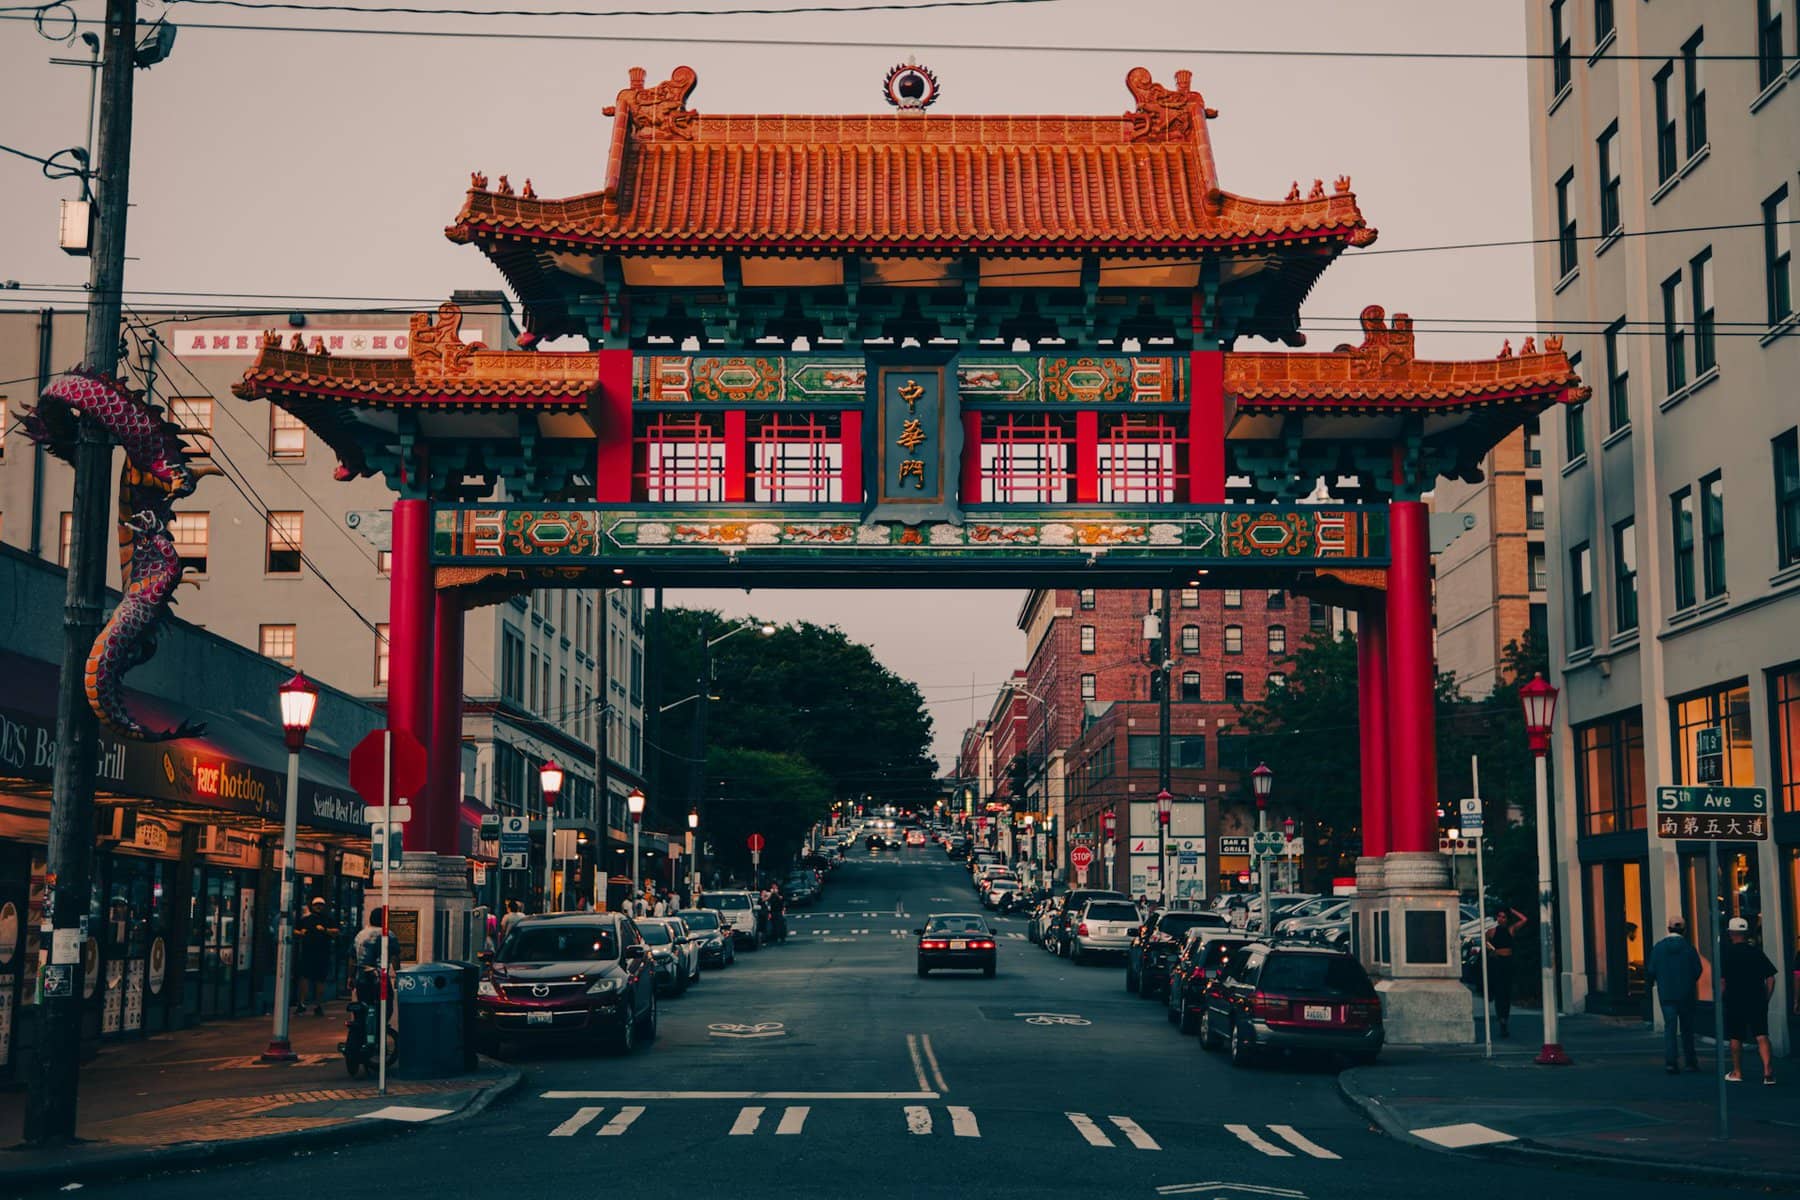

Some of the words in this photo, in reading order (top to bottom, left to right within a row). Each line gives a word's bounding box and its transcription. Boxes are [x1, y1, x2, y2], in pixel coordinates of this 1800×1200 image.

[896, 379, 927, 489] 中華門
[220, 762, 264, 812] hotdog
[335, 798, 349, 823] Best
[1661, 789, 1692, 810] 5th
[1704, 793, 1732, 808] Ave
[1753, 794, 1763, 808] S
[1661, 817, 1764, 836] 南第五大道
[1073, 852, 1091, 861] STOP
